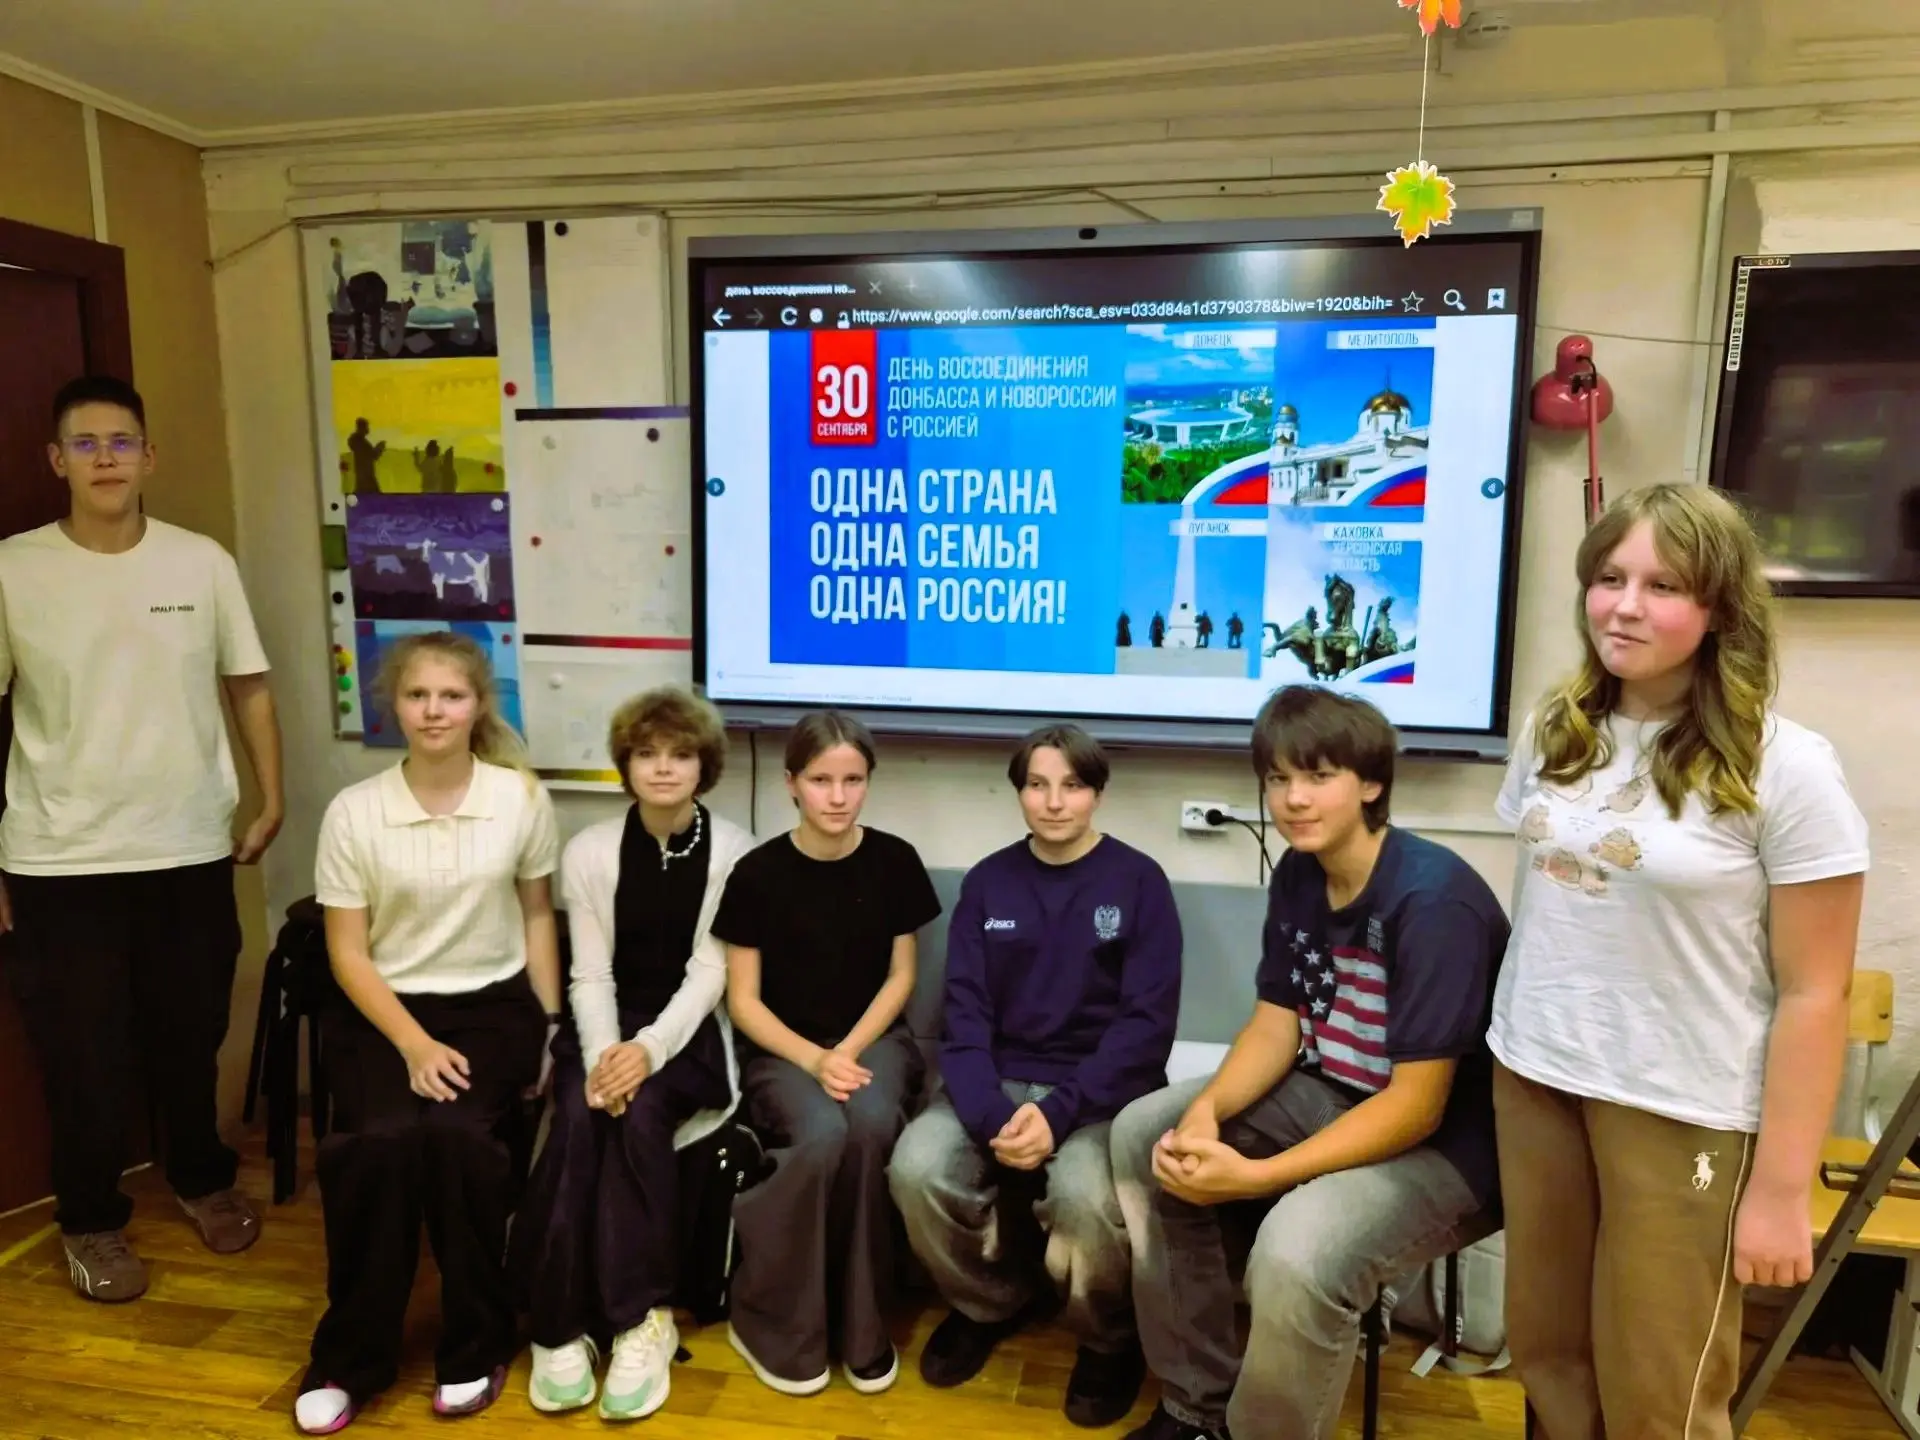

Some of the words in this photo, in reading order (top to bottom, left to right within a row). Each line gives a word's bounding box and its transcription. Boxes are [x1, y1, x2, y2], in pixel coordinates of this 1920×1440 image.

[725, 286, 751, 297] день
[752, 284, 832, 297] воссоединения
[852, 295, 1393, 325] https://www.google.com/search?sca_esv=033d84a1d3790378&biw=1920&bih=
[1348, 334, 1419, 346] МЕЛИТОПОЛЬ
[888, 358, 933, 382] ДЕНЬ
[939, 356, 1088, 381] ВОССОЕДИНЕНИЯ
[817, 364, 868, 418] 30
[888, 386, 979, 411] ДОНБАССА
[986, 387, 996, 408] И
[1001, 386, 1116, 409] НОВОРОССИИ
[817, 422, 867, 436] СЕНТЯБРЯ
[887, 416, 898, 437] С
[903, 413, 979, 438] РОССИЕЙ
[810, 468, 907, 517] ОДНА
[918, 469, 1057, 514] СТРАНА
[1332, 526, 1384, 539] КАХОВКА
[810, 521, 907, 571] ОДНА
[918, 524, 1039, 569] СЕМЬЯ
[810, 575, 907, 624] ОДНА
[917, 578, 1067, 624] РОССИЯ!
